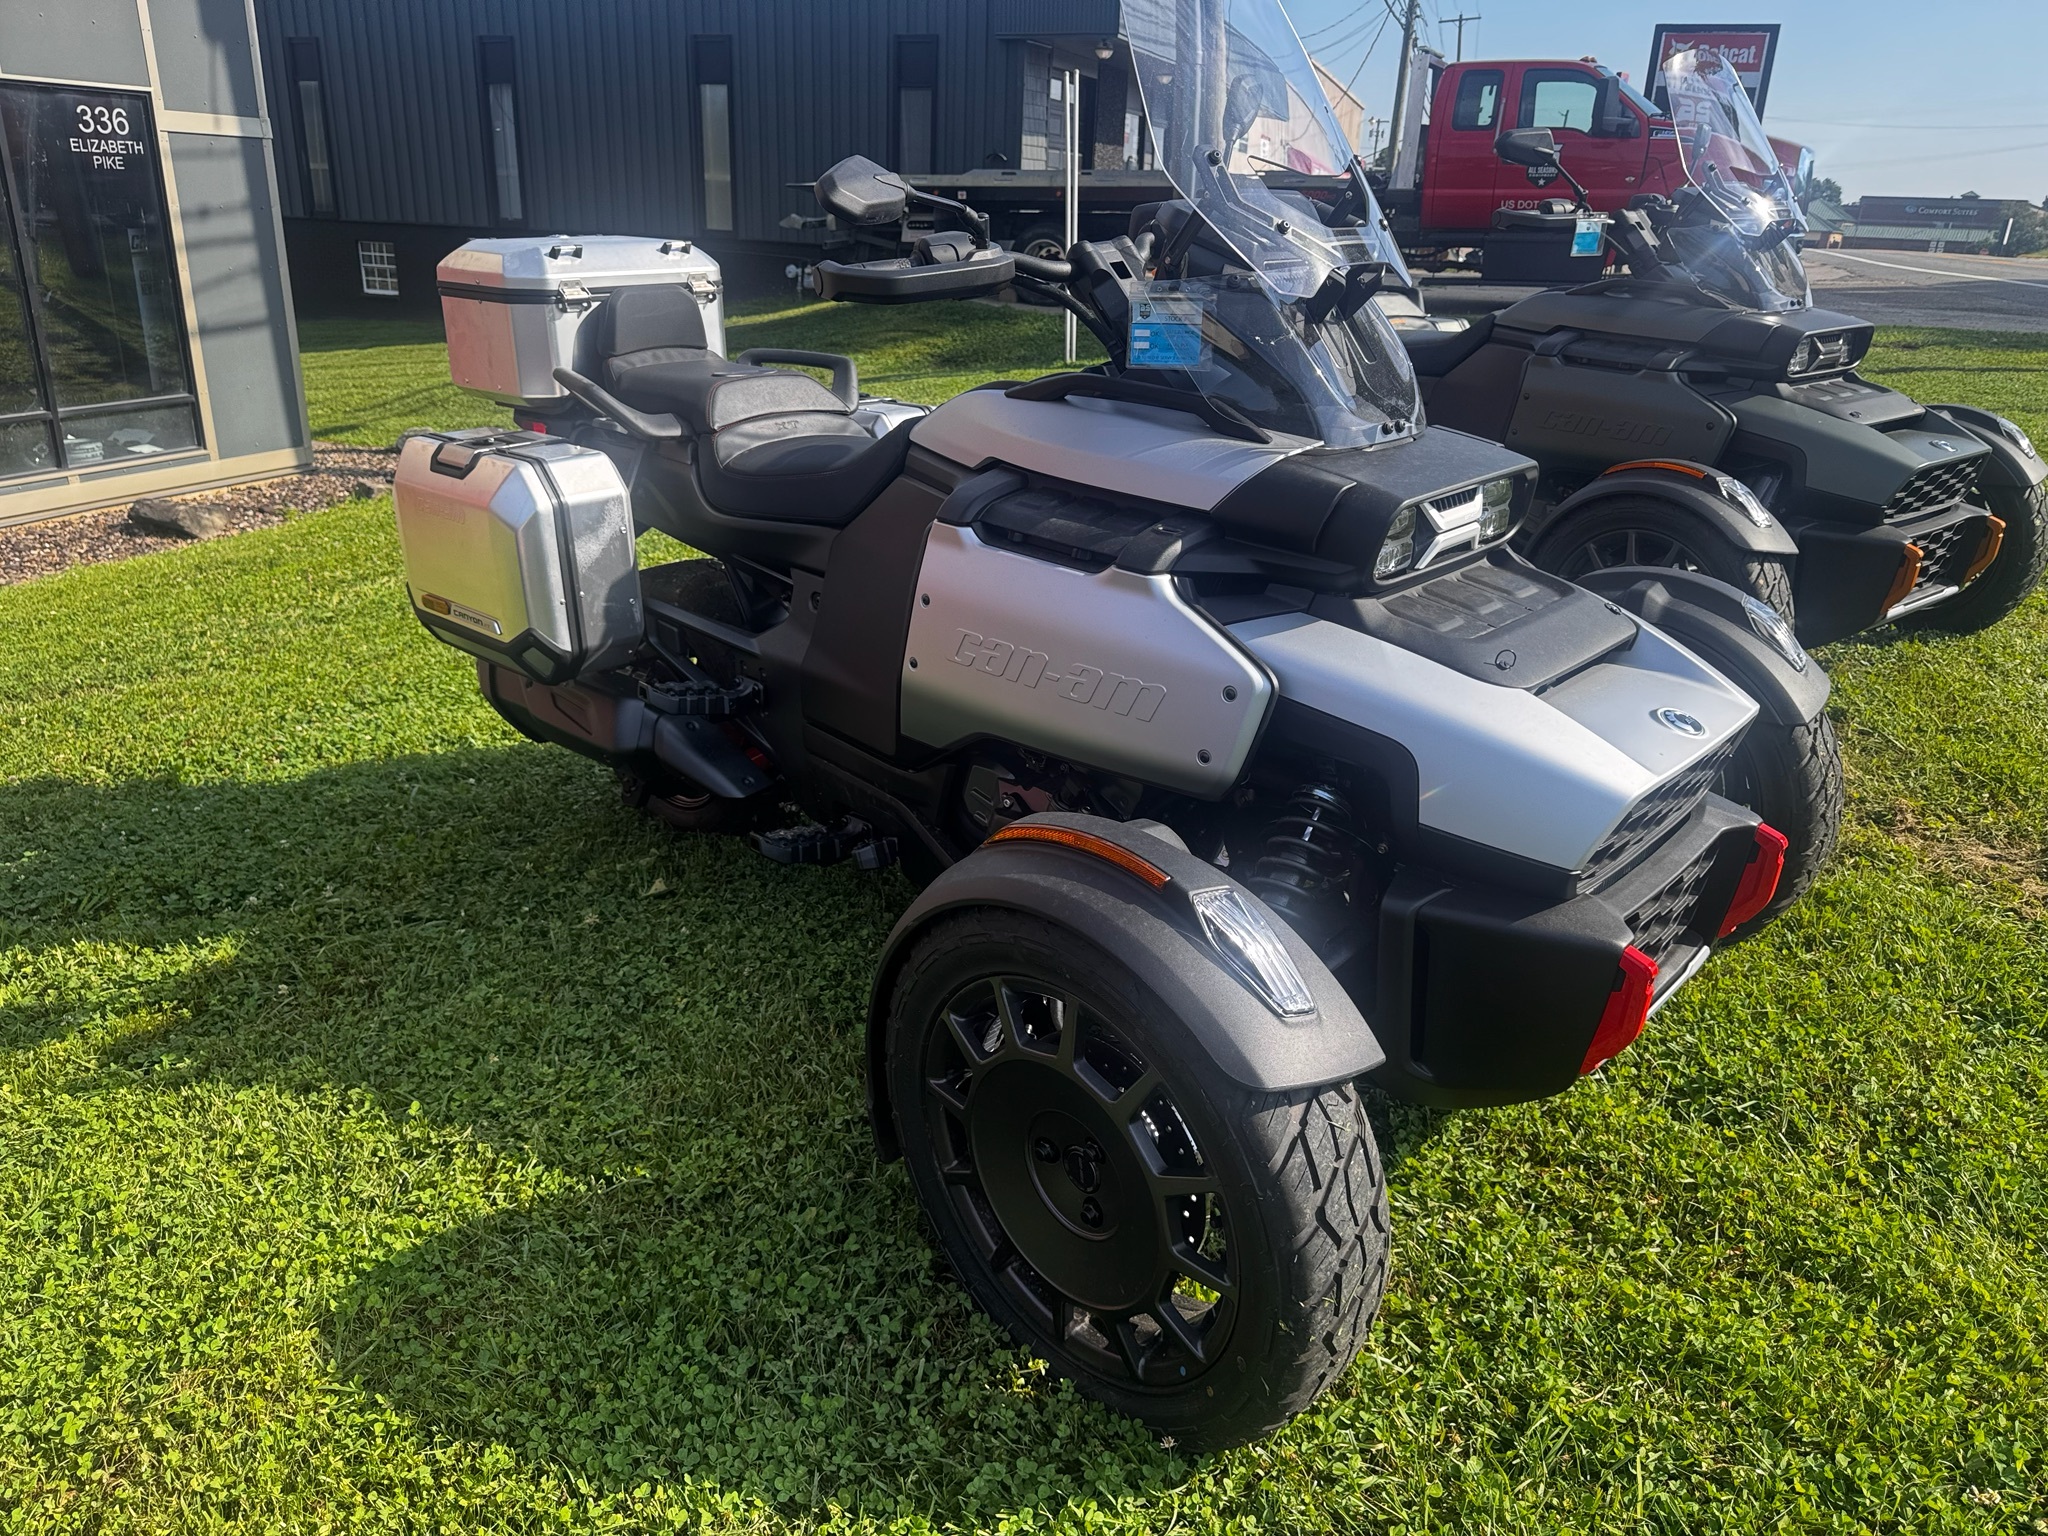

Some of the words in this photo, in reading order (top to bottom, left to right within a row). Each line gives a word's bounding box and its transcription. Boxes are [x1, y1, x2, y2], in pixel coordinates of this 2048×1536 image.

[76, 104, 130, 136] 336
[69, 137, 144, 155] ELIZABETH
[92, 155, 125, 170] PIKE
[1500, 200, 1515, 209] US
[1517, 200, 1540, 209] DOT
[774, 419, 800, 431] XT
[1536, 410, 1674, 447] can-am
[946, 627, 1168, 723] can-am
